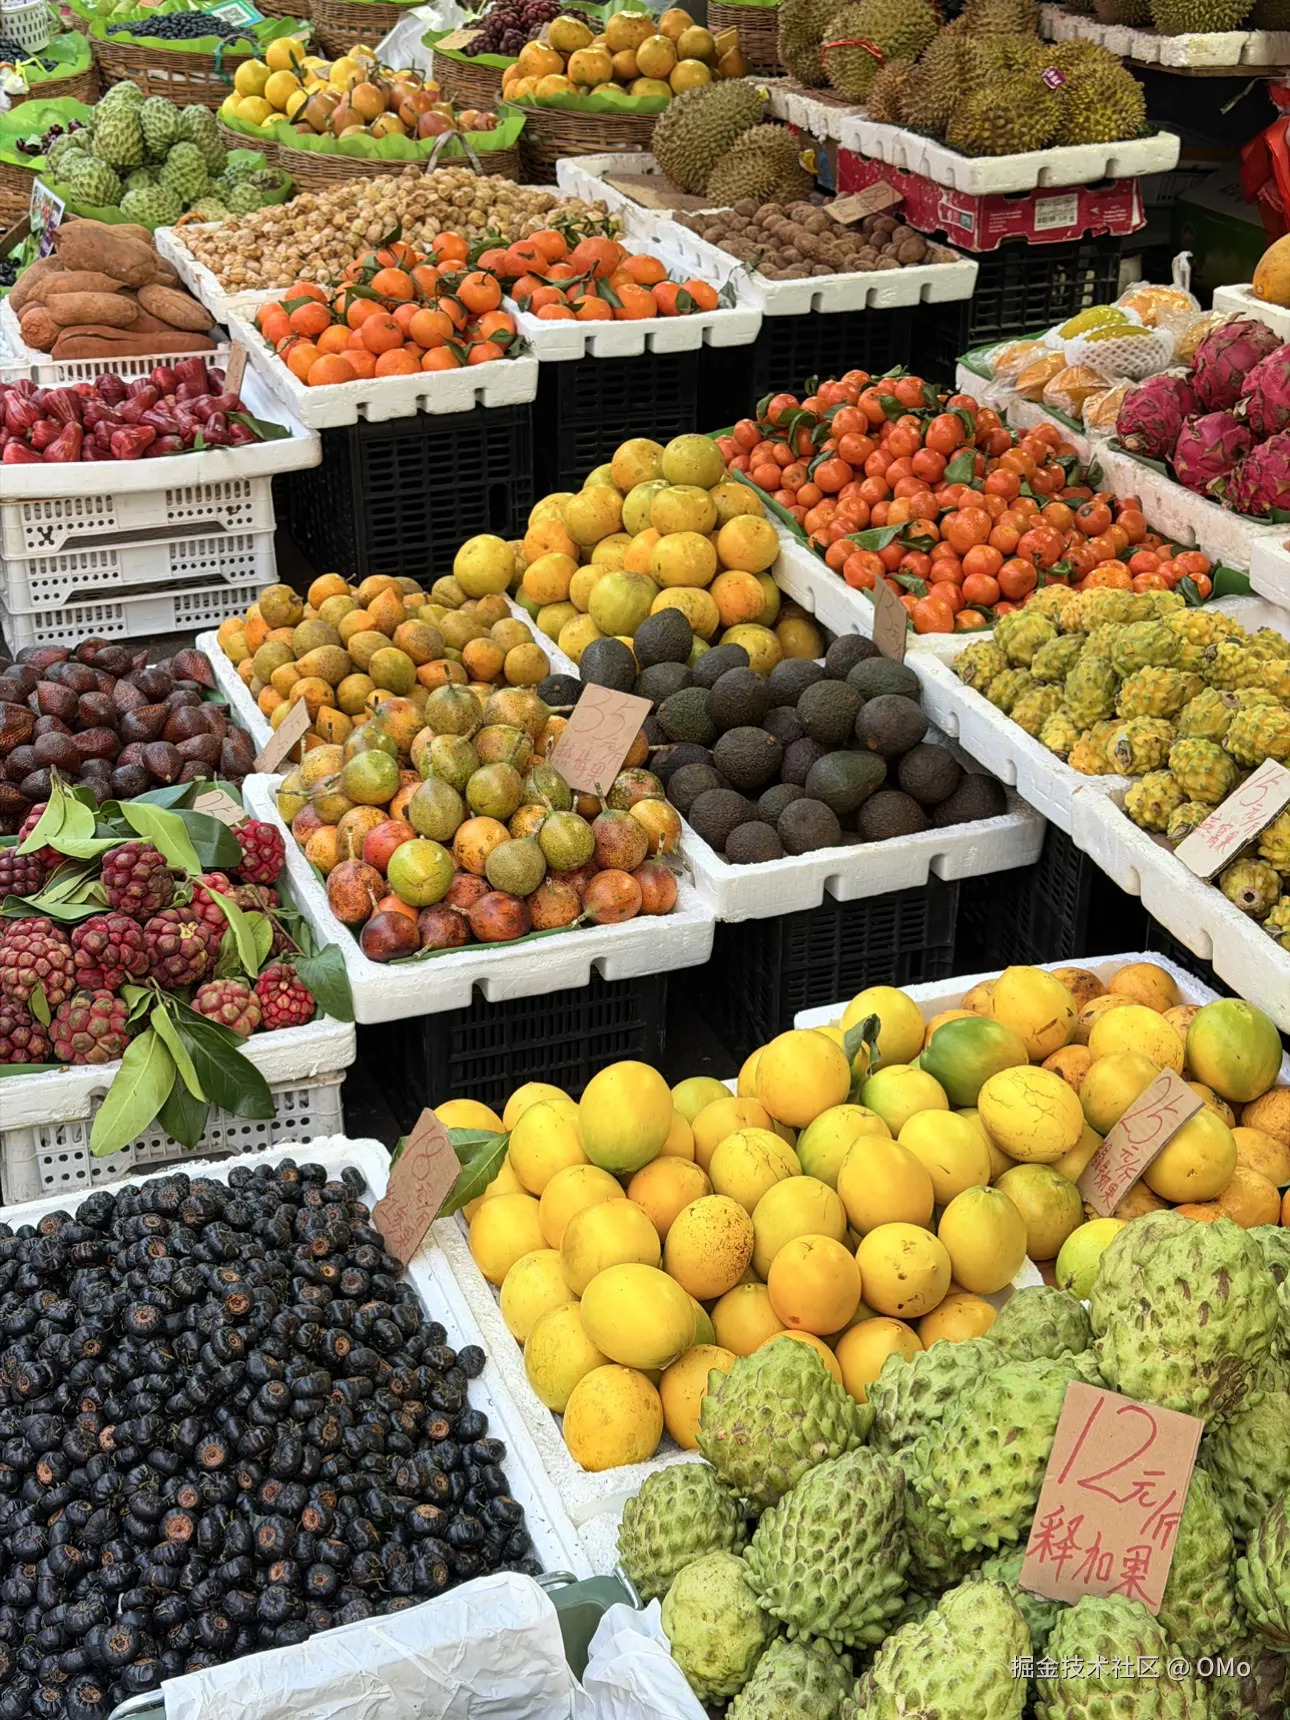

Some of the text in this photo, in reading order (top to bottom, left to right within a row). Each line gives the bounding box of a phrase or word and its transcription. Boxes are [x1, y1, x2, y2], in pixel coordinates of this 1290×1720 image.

[1057, 1396, 1181, 1551] 12元/斤
[1026, 1505, 1158, 1607] 释加果
